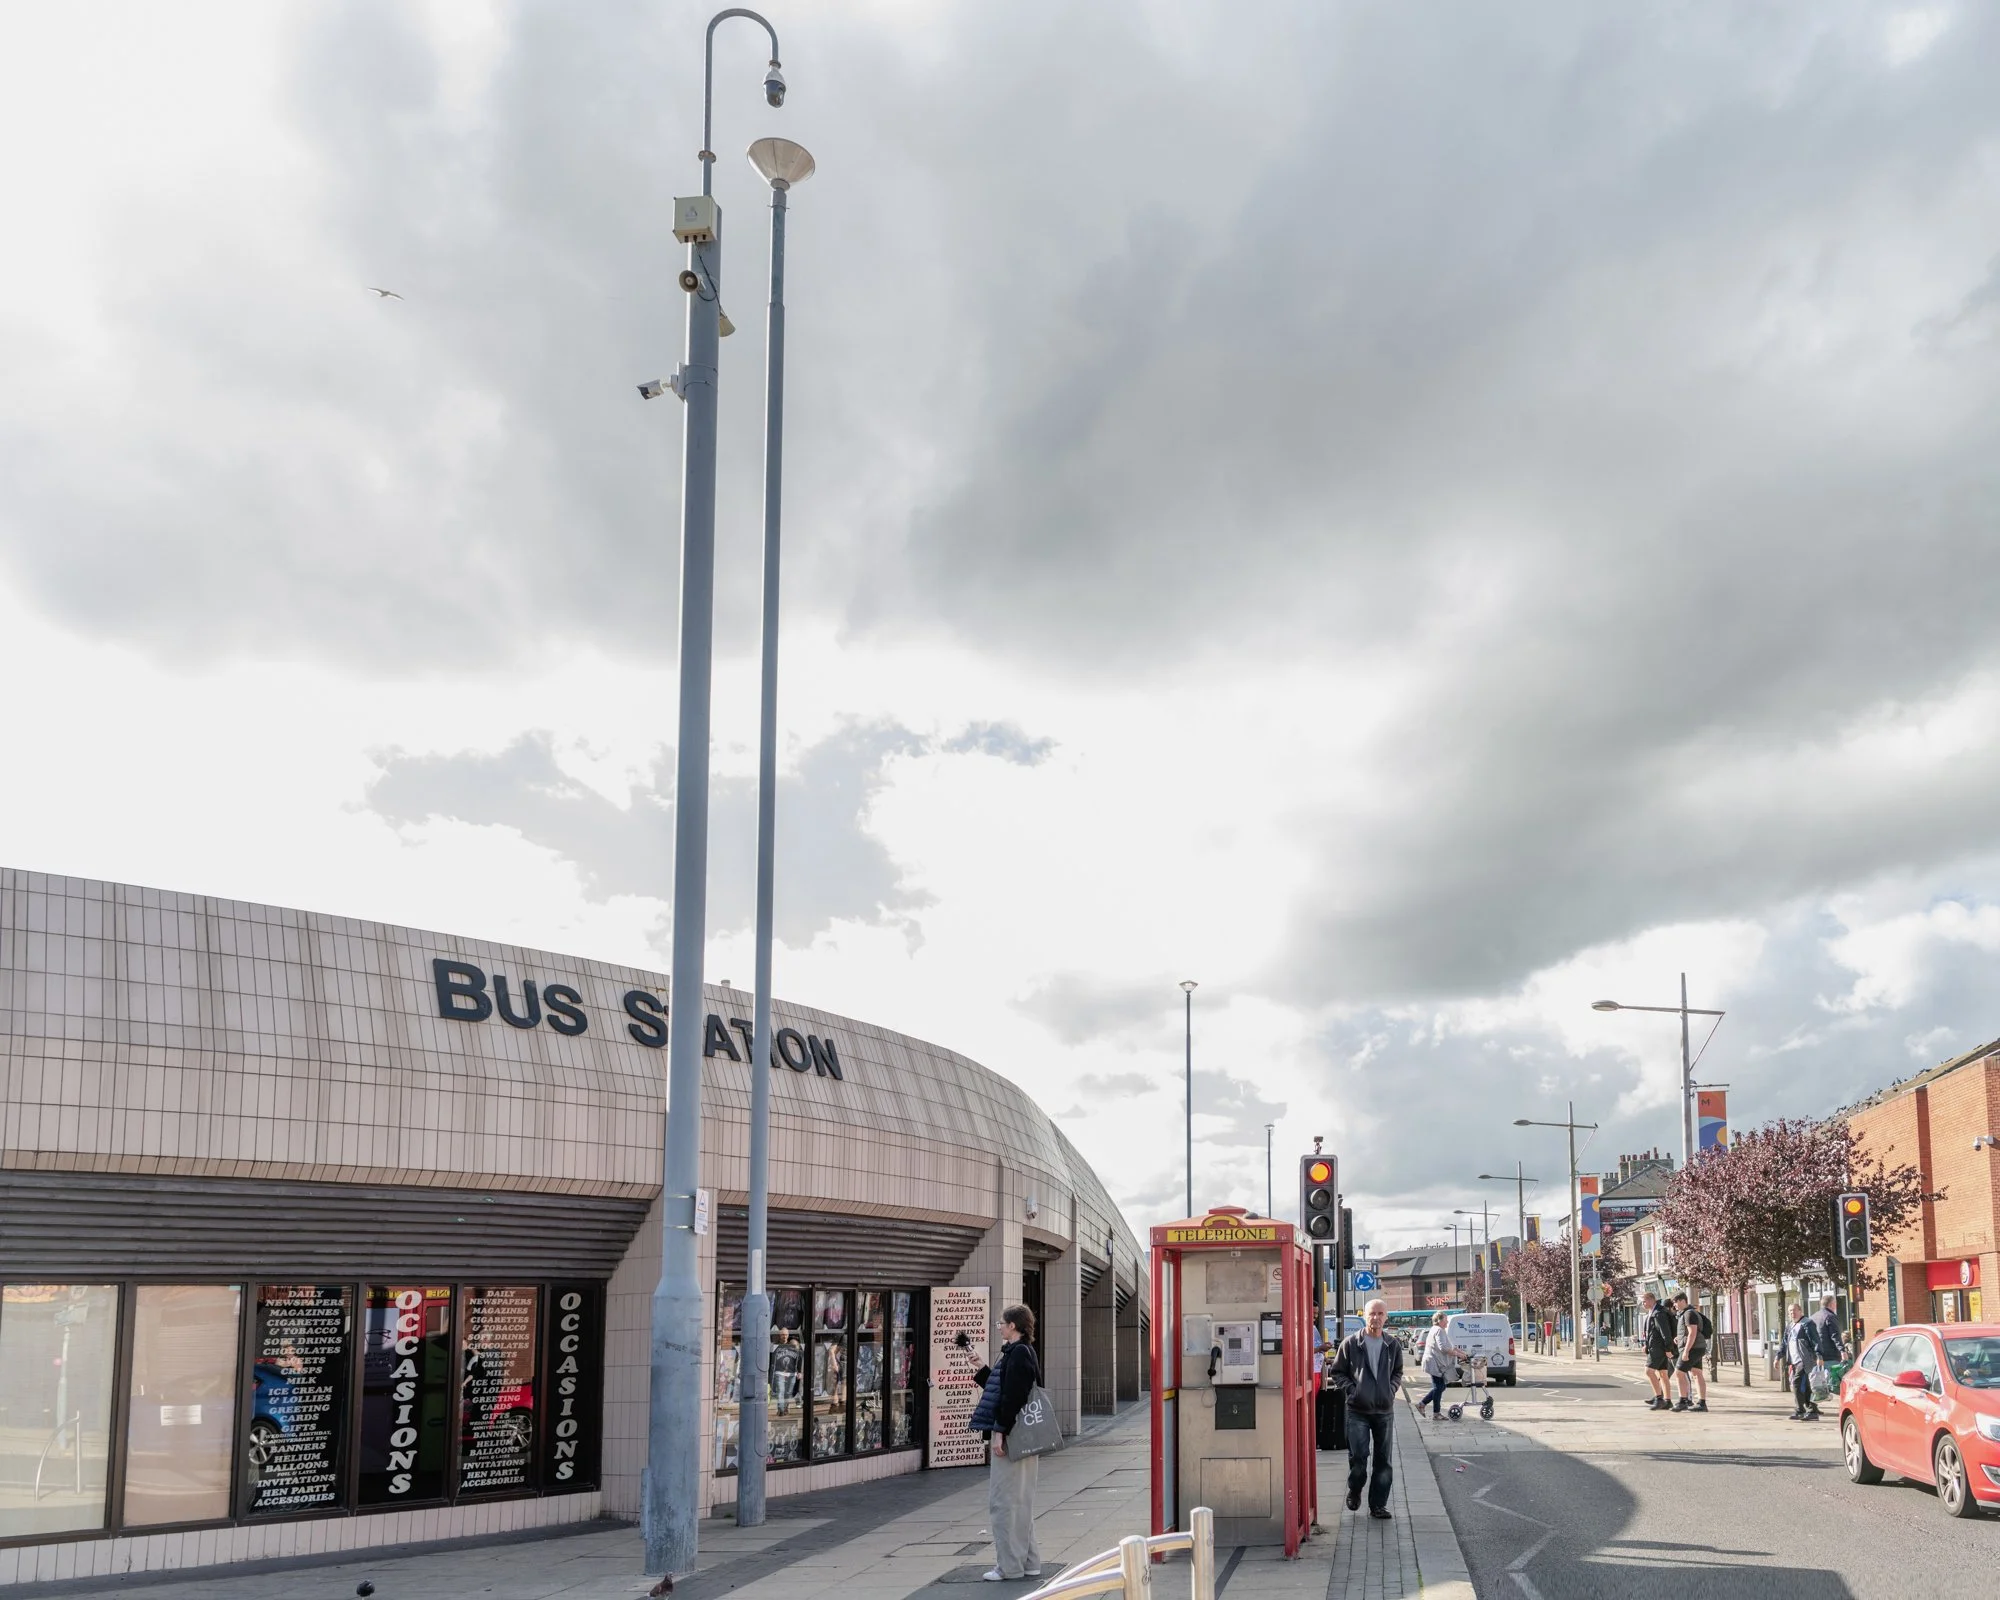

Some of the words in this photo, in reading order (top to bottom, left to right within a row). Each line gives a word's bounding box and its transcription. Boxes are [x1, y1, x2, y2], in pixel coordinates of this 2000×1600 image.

[432, 958, 589, 1037] BUS
[1174, 1229, 1268, 1242] TELEPHONE
[265, 1299, 345, 1307] NEWSPAPERS
[269, 1309, 340, 1317] MAGAZINES
[266, 1318, 341, 1327] CIGARETTES
[282, 1327, 338, 1335] TOBACCO
[263, 1338, 295, 1346] SOFT
[297, 1337, 343, 1345] DRINKS
[262, 1347, 341, 1356] CHOCOLATES
[479, 1351, 518, 1359] SWEETS
[277, 1357, 326, 1365] SWEETS
[281, 1367, 323, 1375] CRISPS
[285, 1377, 317, 1385] MILK
[483, 1386, 522, 1394] LOLLIES
[554, 1292, 582, 1480] OCCASIONS
[268, 1388, 289, 1396] ICE
[292, 1386, 333, 1395] CREAM
[386, 1290, 422, 1494] OCCASIONS
[282, 1394, 332, 1404] LOLLIES
[472, 1395, 521, 1403] GREETING
[269, 1404, 330, 1414] GREETING
[480, 1403, 513, 1411] CARDS
[280, 1413, 319, 1422] CARDS
[281, 1423, 317, 1433] GIFTS
[943, 1421, 968, 1429] HELIU
[473, 1430, 517, 1439] BANNERS
[269, 1442, 327, 1453] BANNERS
[476, 1439, 514, 1448] HELIUM
[933, 1439, 985, 1447] INVITATIONS
[469, 1447, 520, 1456] BALLOONS
[273, 1453, 321, 1463] HELIUM
[935, 1454, 984, 1463] ACCESORIES
[265, 1461, 329, 1473] BALLOONS
[463, 1459, 525, 1470] INVITATIONS
[467, 1471, 488, 1479] HEN
[490, 1468, 520, 1477] PARTY
[256, 1474, 336, 1488] INVITATIONS
[461, 1476, 525, 1488] ACCESSORIES
[262, 1487, 288, 1497] HEN
[291, 1484, 330, 1495] PARTY
[254, 1492, 336, 1507] ACCESSORIES
